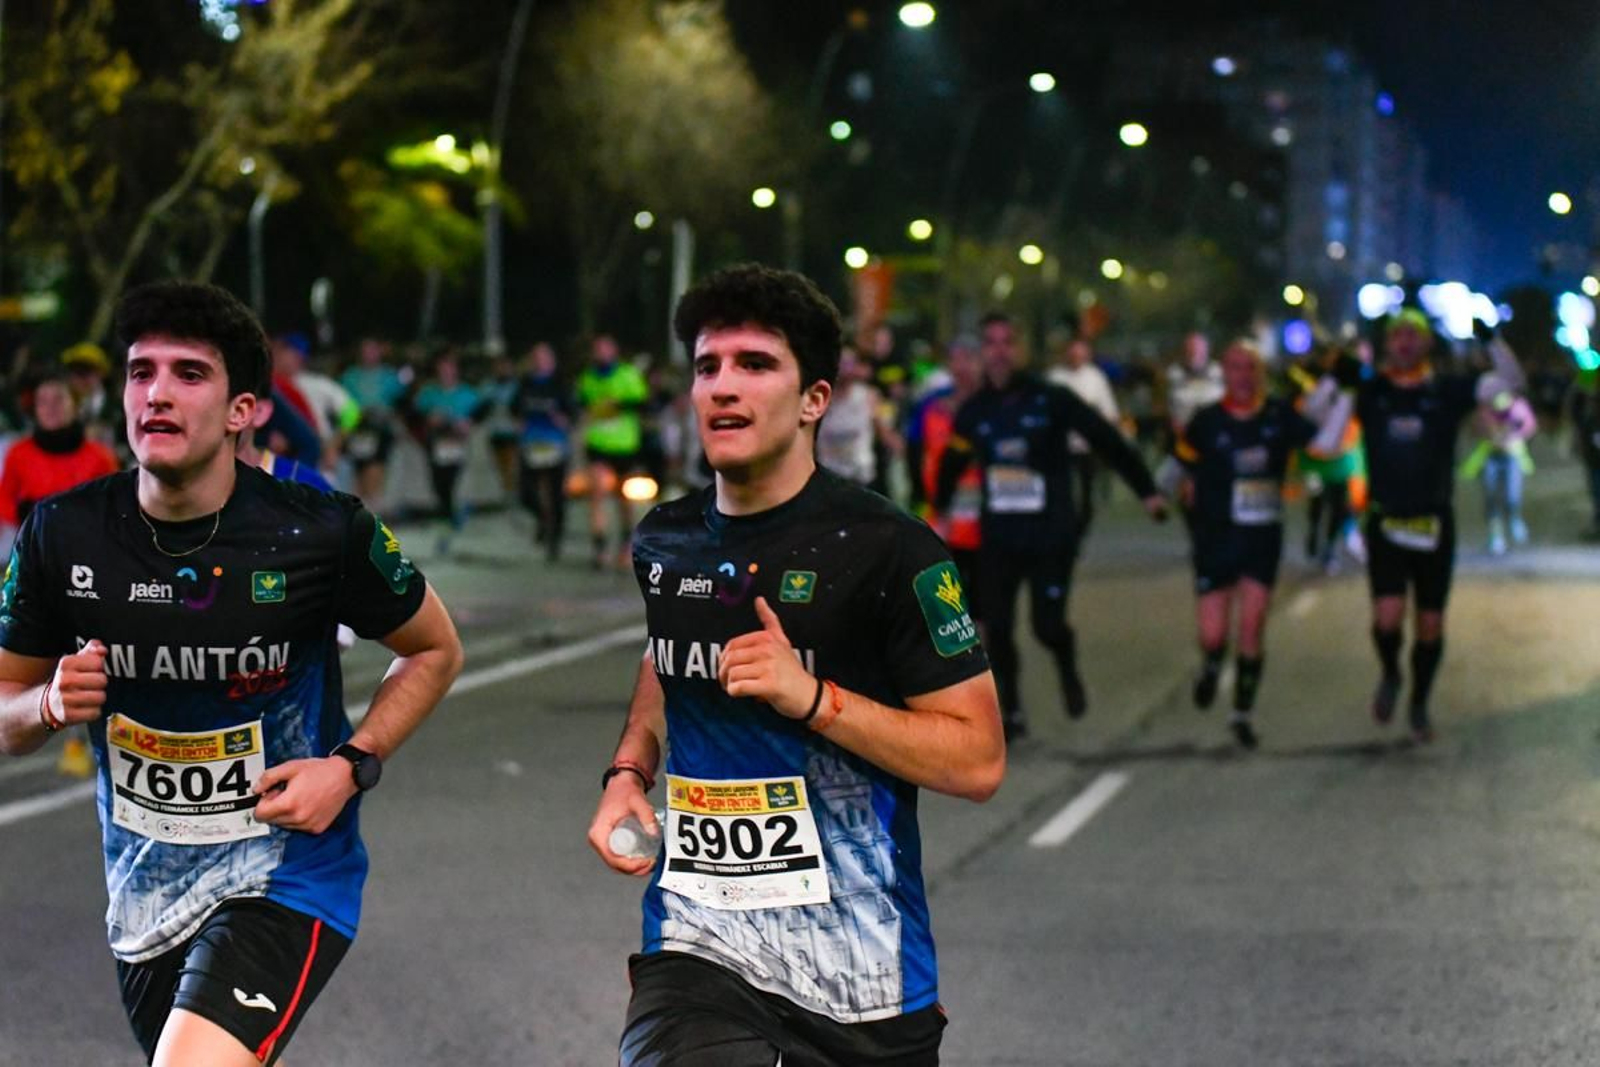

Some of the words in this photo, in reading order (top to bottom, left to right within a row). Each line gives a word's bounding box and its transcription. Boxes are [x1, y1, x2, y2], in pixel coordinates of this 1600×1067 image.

[151, 636, 290, 681] ANTÓN
[119, 750, 251, 802] 7604
[678, 814, 804, 860] 5902
